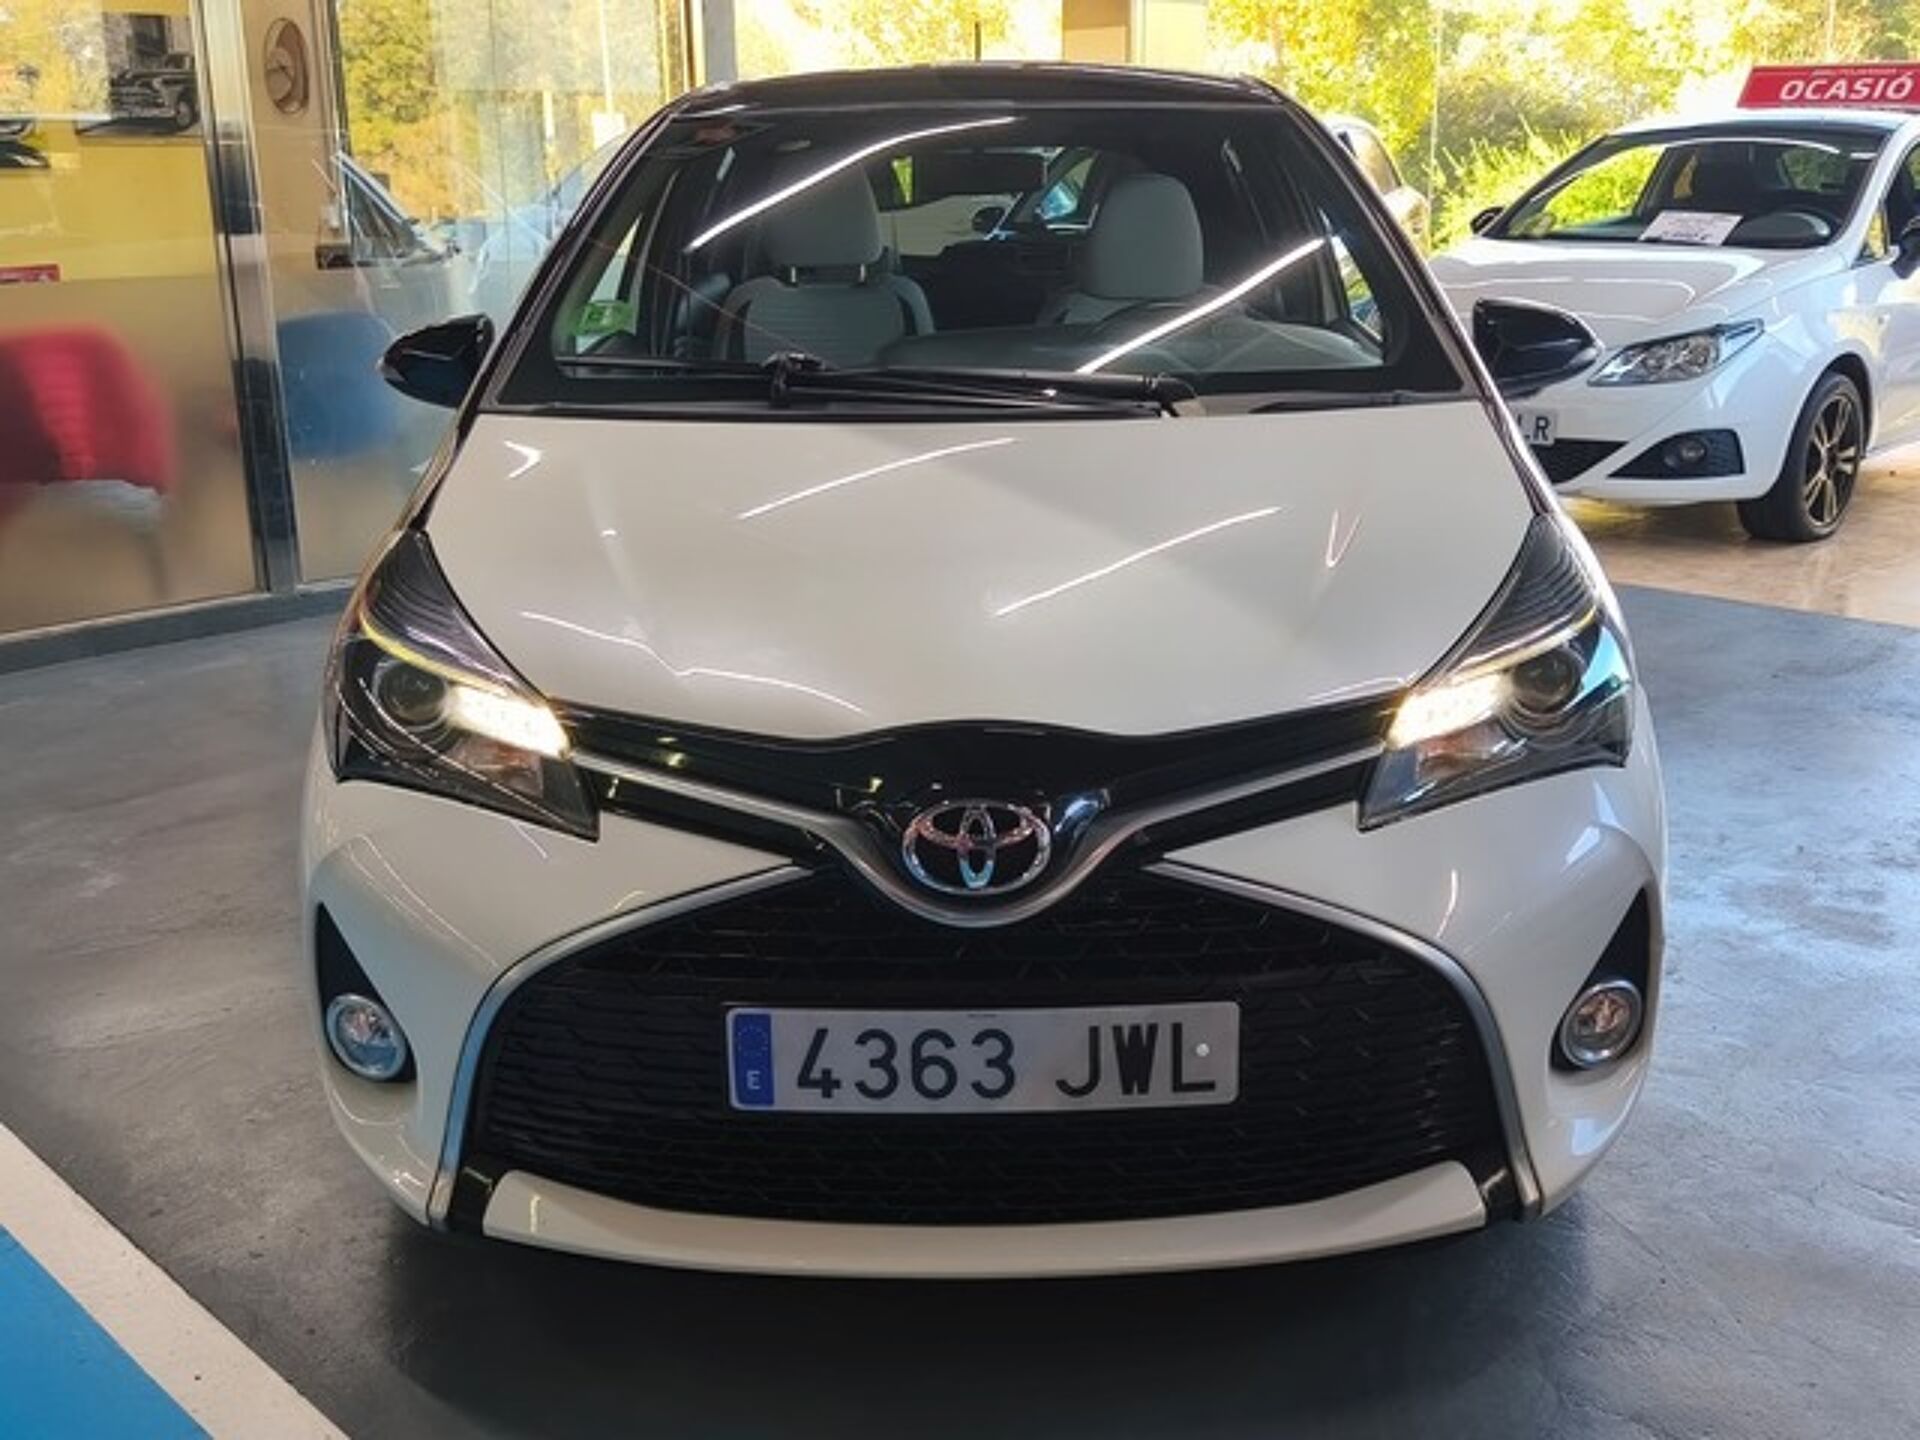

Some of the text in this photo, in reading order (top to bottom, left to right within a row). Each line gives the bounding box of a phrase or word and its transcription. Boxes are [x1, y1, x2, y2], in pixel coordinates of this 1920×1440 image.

[1778, 72, 1914, 101] OCASIÓ
[796, 1022, 1217, 1099] 4363 JWL
[746, 1070, 760, 1090] E
